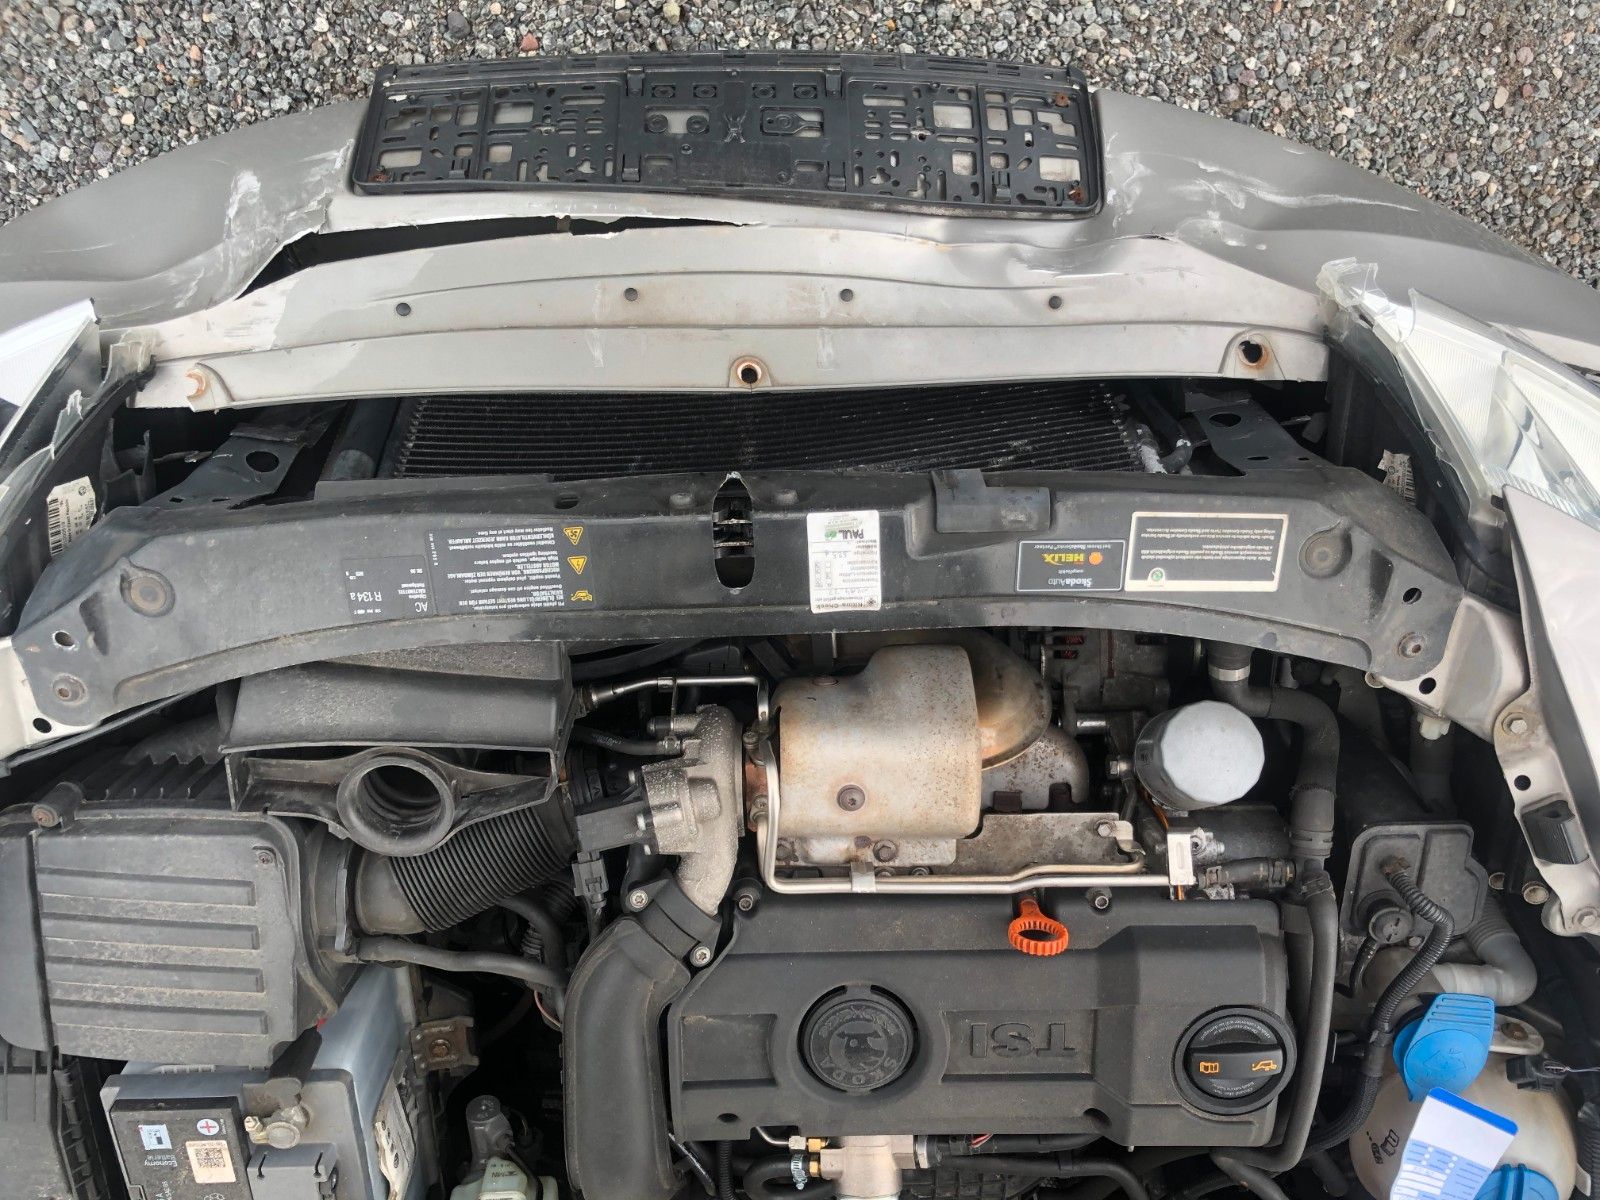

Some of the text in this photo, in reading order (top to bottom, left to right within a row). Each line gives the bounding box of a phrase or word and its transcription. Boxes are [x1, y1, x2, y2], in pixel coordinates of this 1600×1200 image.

[1044, 552, 1084, 563] HELIX
[414, 601, 427, 612] AC
[970, 1022, 1078, 1058] TSI
